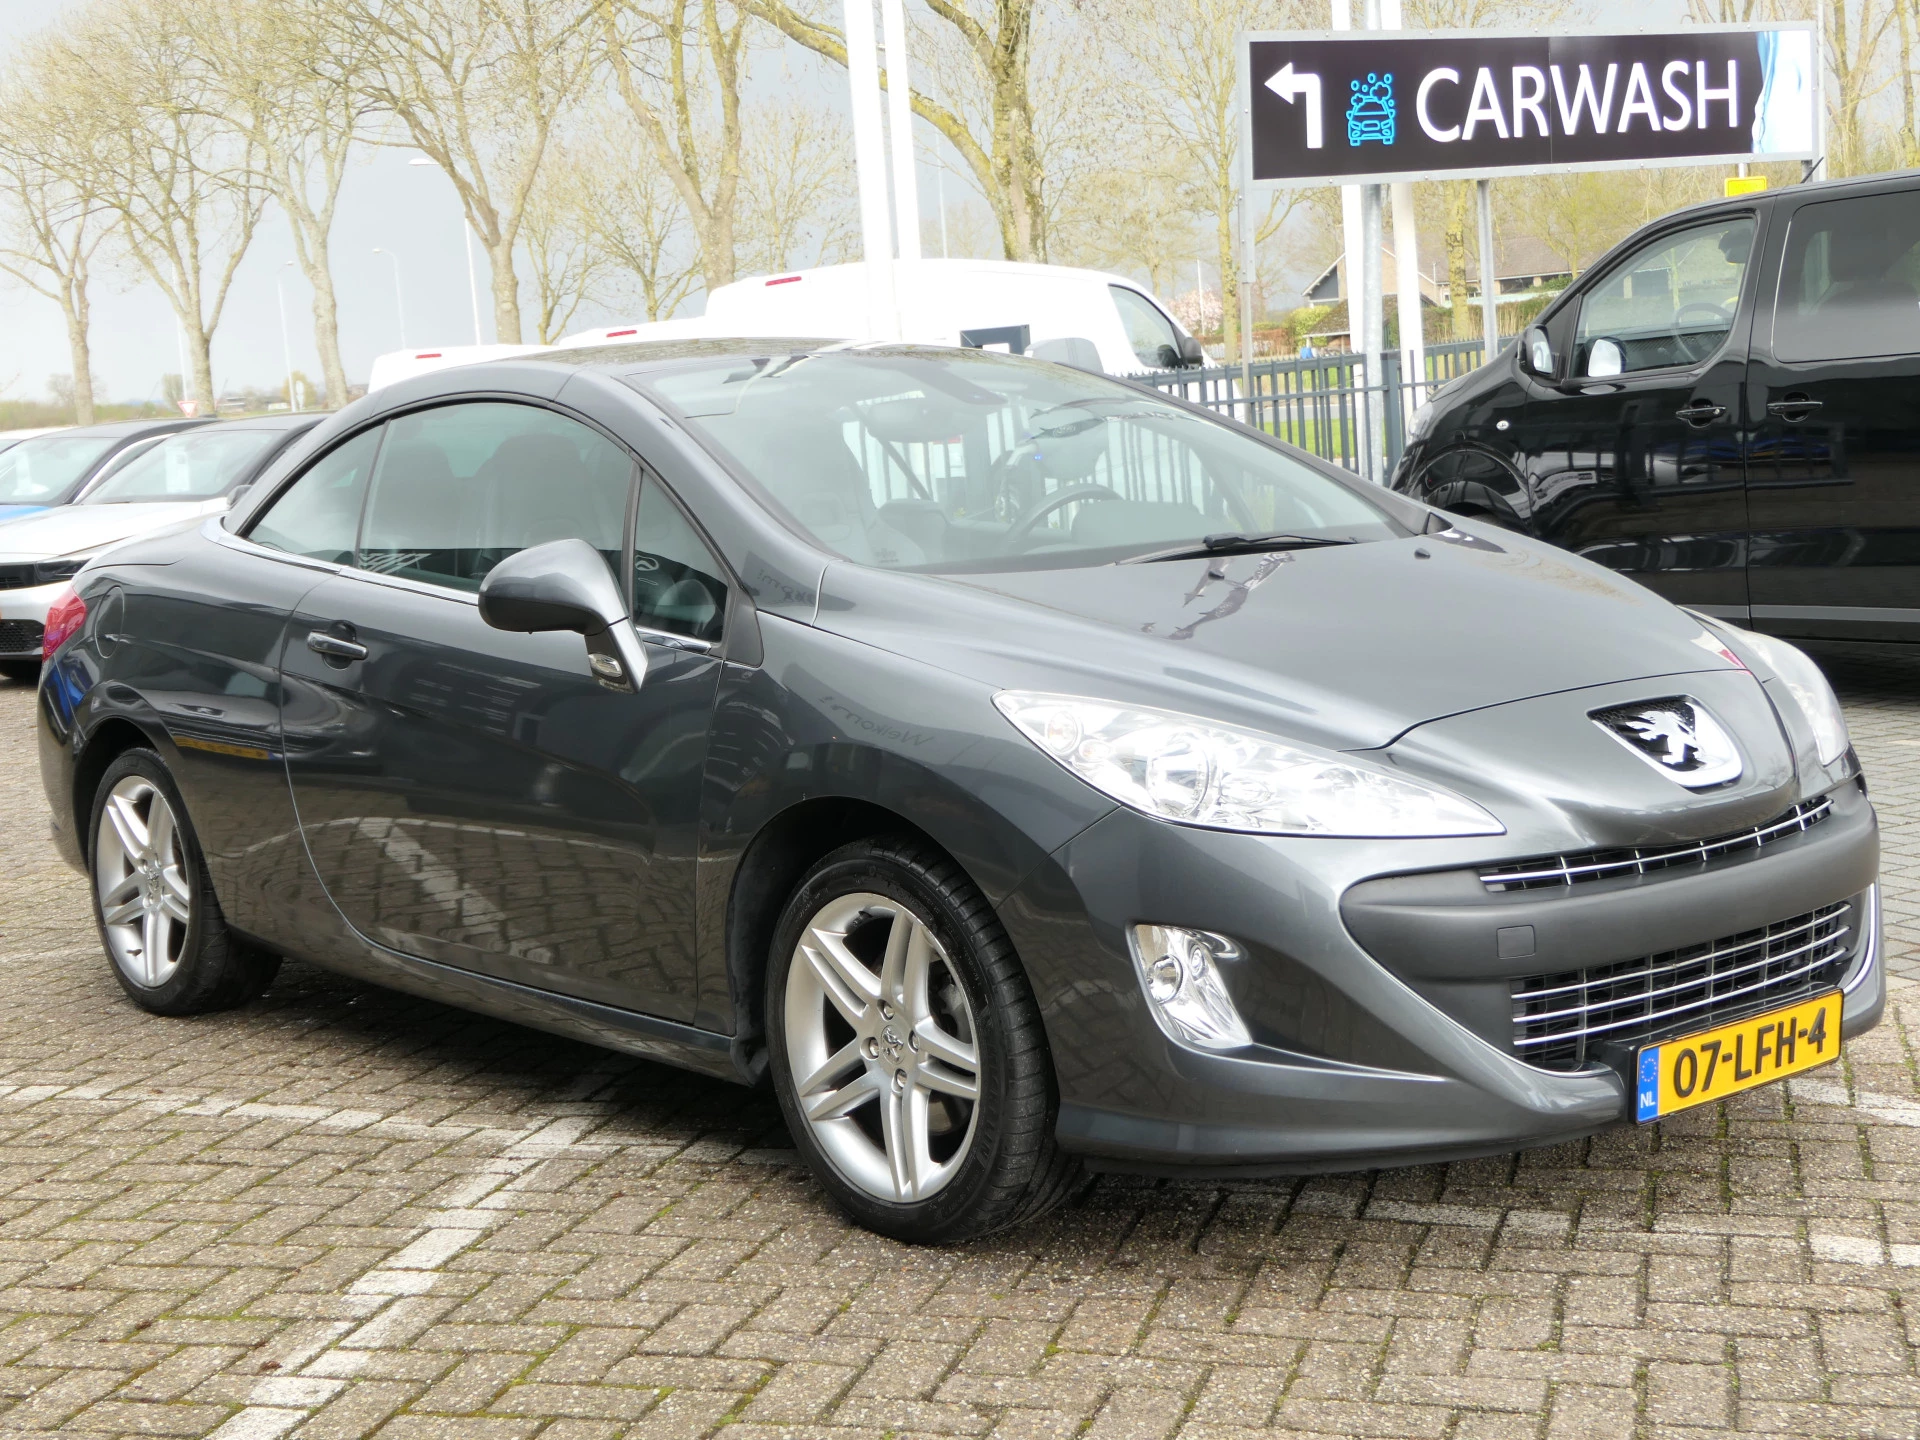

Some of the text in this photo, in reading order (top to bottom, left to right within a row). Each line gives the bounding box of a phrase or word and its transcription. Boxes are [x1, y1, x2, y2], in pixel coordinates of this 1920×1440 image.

[1416, 60, 1737, 142] CARWASH
[1673, 1007, 1826, 1099] 07-LFH-4
[1640, 1091, 1656, 1109] NL
